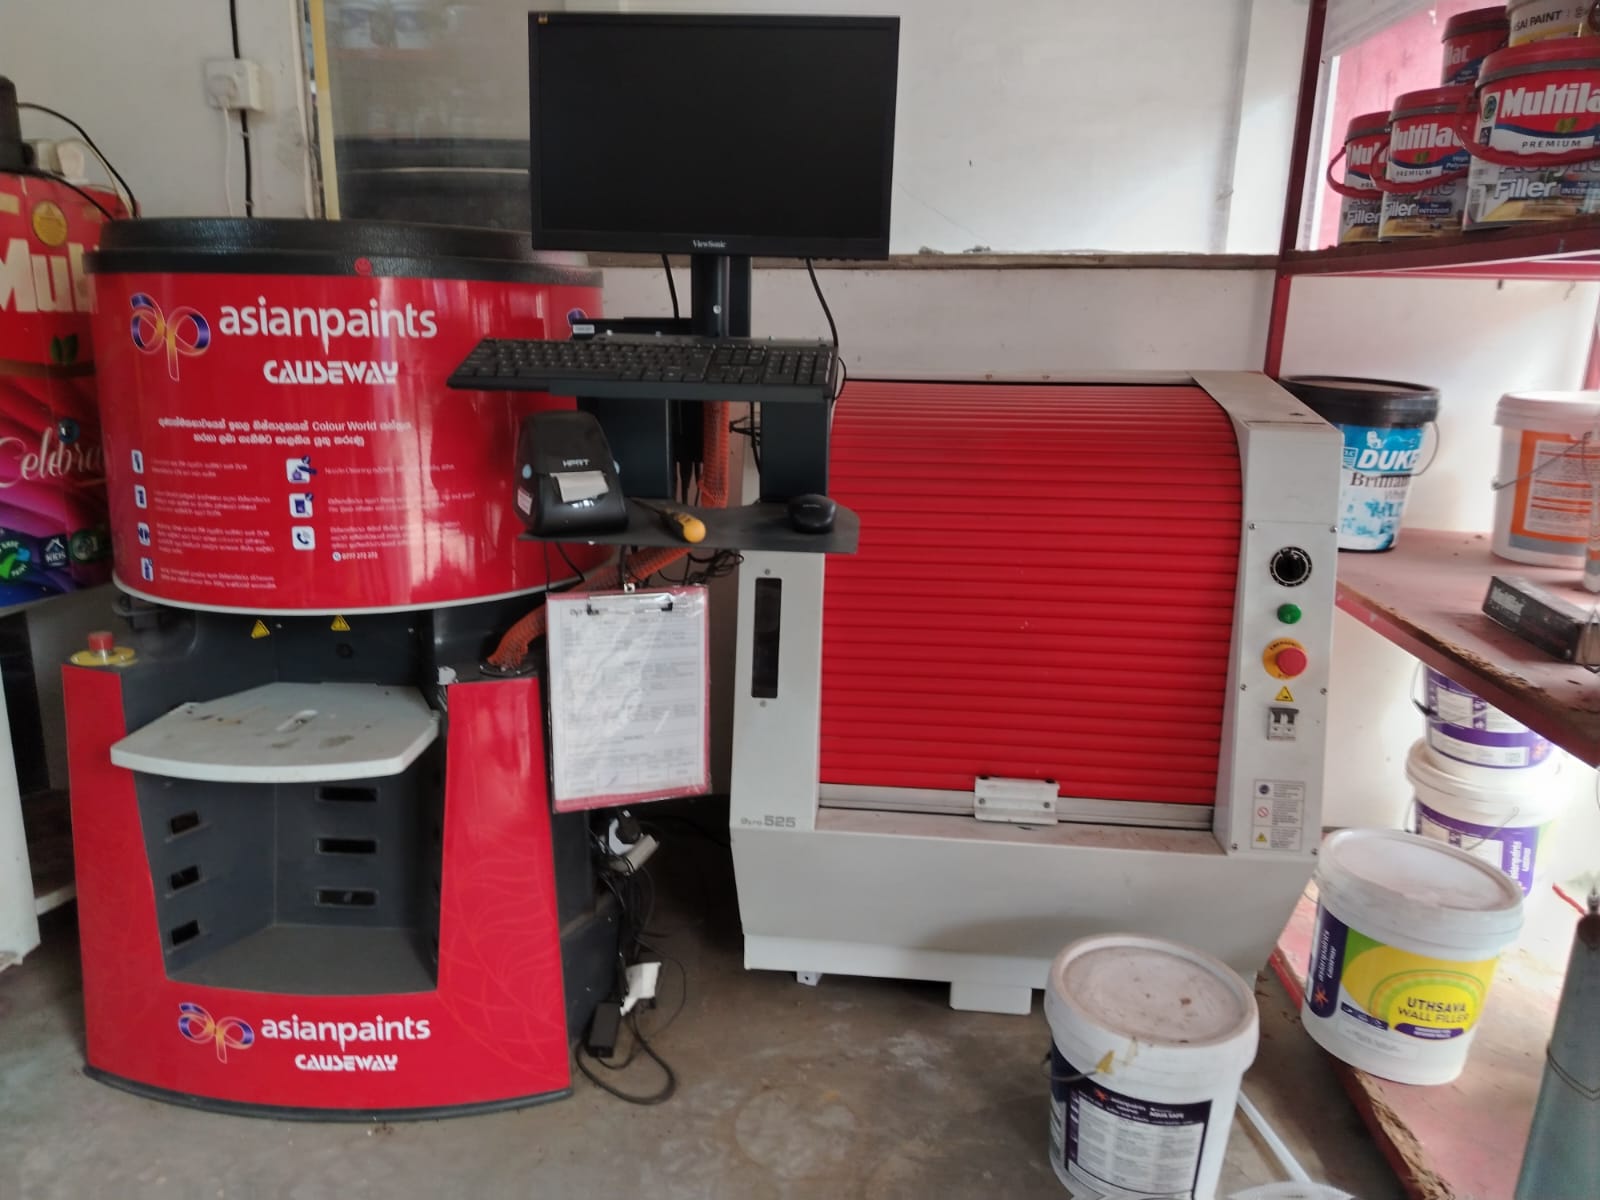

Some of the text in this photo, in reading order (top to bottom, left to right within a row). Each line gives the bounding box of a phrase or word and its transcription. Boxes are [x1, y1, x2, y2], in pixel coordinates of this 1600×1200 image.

[1530, 10, 1562, 26] PAINT
[1521, 139, 1582, 149] PREMIUM
[1495, 178, 1557, 200] Filler
[218, 295, 438, 355] asianpaints
[262, 360, 399, 385] CAUSEWAY
[312, 420, 345, 432] Colour
[346, 420, 376, 432] World
[1357, 448, 1420, 471] DUKE
[764, 816, 796, 828] 525
[1407, 996, 1467, 1013] UTHSAVA
[1398, 1006, 1431, 1022] WALL
[1434, 1012, 1470, 1024] FILLER
[261, 1014, 432, 1052] asianpaints
[294, 1054, 398, 1071] CAUSEWAY
